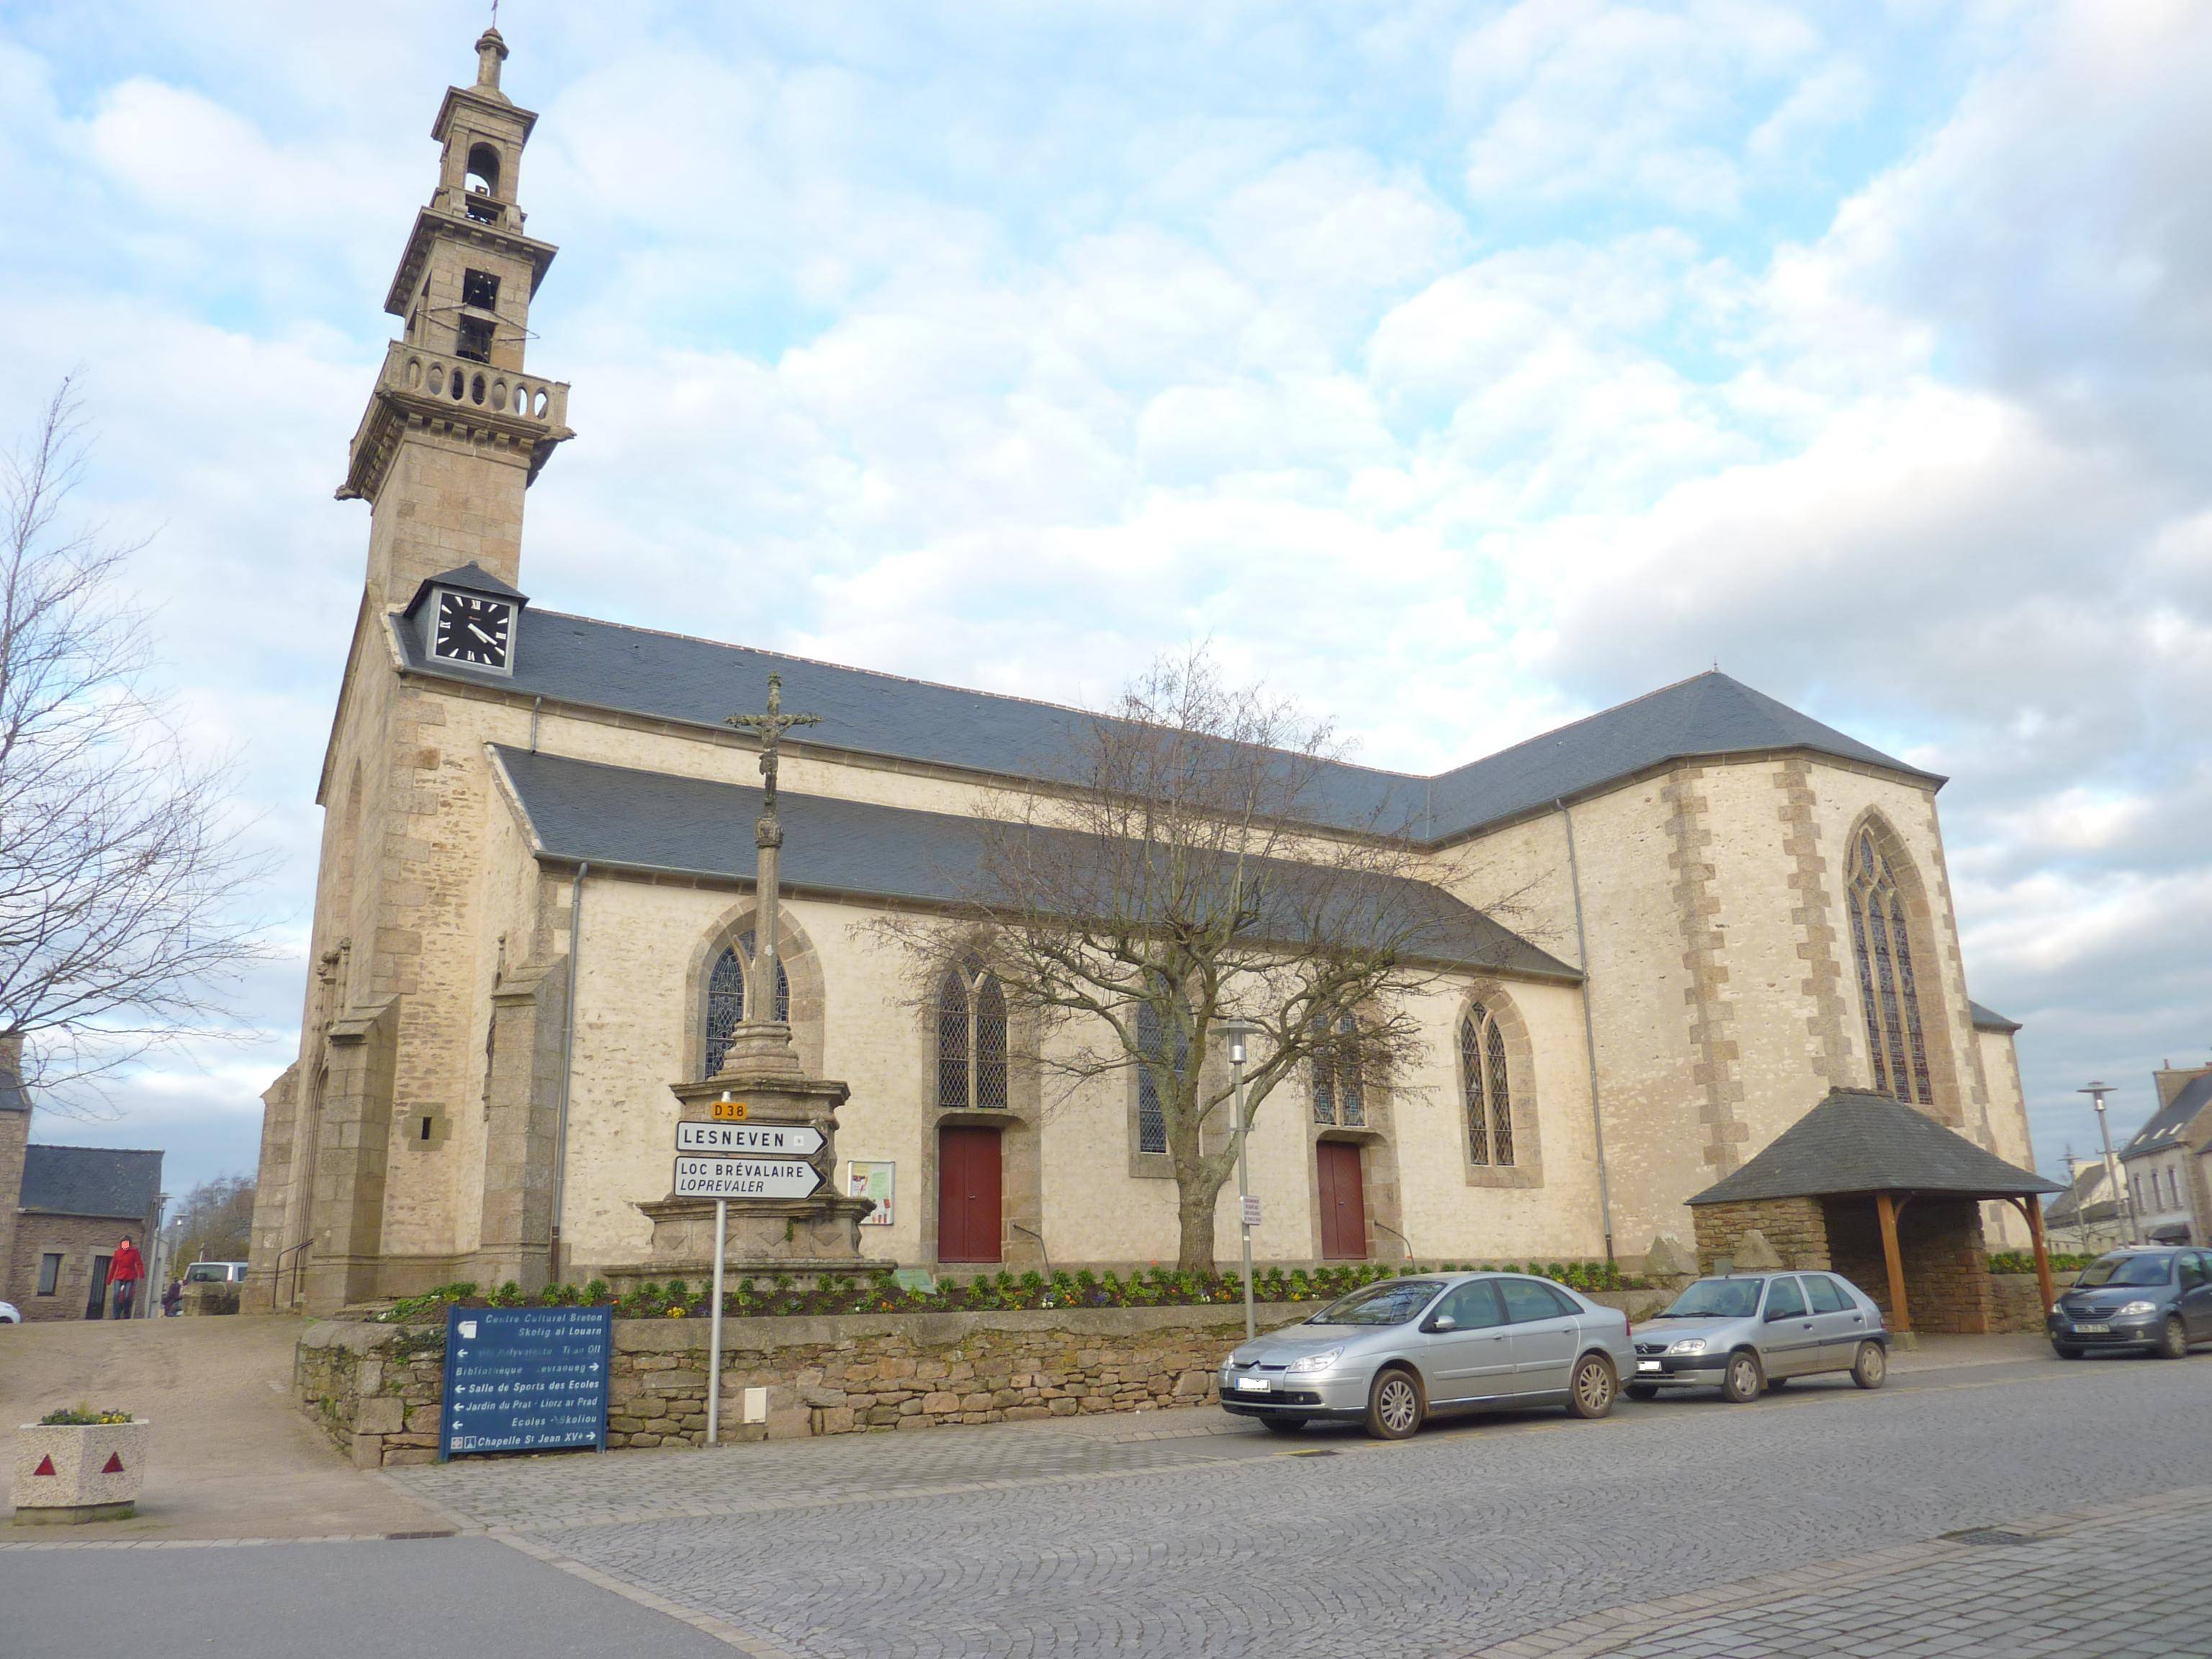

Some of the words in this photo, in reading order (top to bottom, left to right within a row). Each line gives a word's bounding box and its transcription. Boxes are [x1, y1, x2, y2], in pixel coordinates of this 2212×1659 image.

[715, 1105, 723, 1116] D
[727, 1105, 745, 1117] 38
[683, 1129, 785, 1147] LESNEVEN
[681, 1163, 708, 1175] LOC
[716, 1161, 804, 1178] BRÉVALAIRE
[680, 1179, 765, 1193] LOPREVALER
[524, 1313, 566, 1323] Culturel
[570, 1313, 603, 1322] Breton
[518, 1327, 552, 1338] Skolig
[568, 1326, 602, 1336] Louarn
[469, 1384, 494, 1393] Salle
[498, 1383, 510, 1393] de
[514, 1382, 545, 1393] Sports
[549, 1381, 565, 1390] des
[569, 1380, 600, 1390] Ecoles
[466, 1401, 496, 1411] Jardin
[499, 1401, 511, 1410] du
[513, 1400, 532, 1409] Prat
[577, 1397, 598, 1406] Prad
[512, 1417, 546, 1427] Ecoles
[477, 1435, 521, 1447] Chapelle
[539, 1434, 561, 1443] Jean
